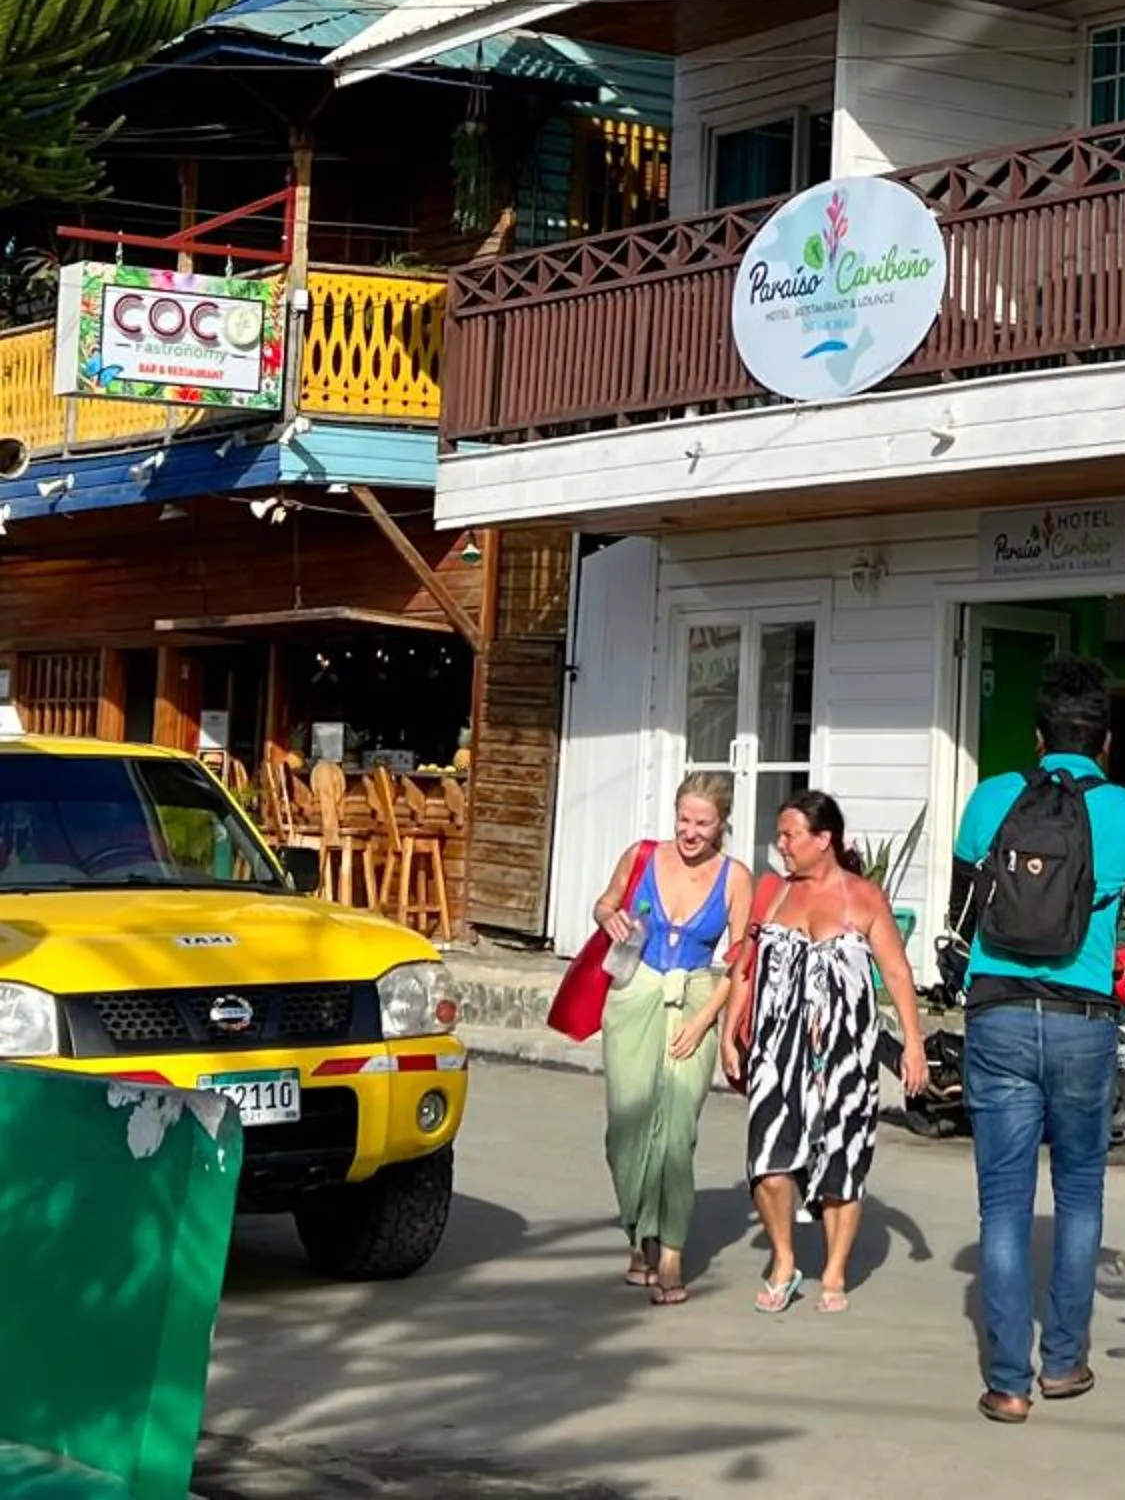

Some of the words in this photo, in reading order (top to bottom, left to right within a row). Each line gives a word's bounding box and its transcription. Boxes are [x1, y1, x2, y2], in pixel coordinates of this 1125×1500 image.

[836, 244, 936, 295] Caribeño
[795, 299, 849, 317] RESTAURANT
[858, 291, 895, 309] LOUNGE
[138, 363, 157, 374] BAR
[168, 365, 225, 380] RESTAURANT
[1057, 509, 1112, 530] HOTEL
[180, 935, 233, 946] TAXI
[208, 1082, 293, 1111] 2110
